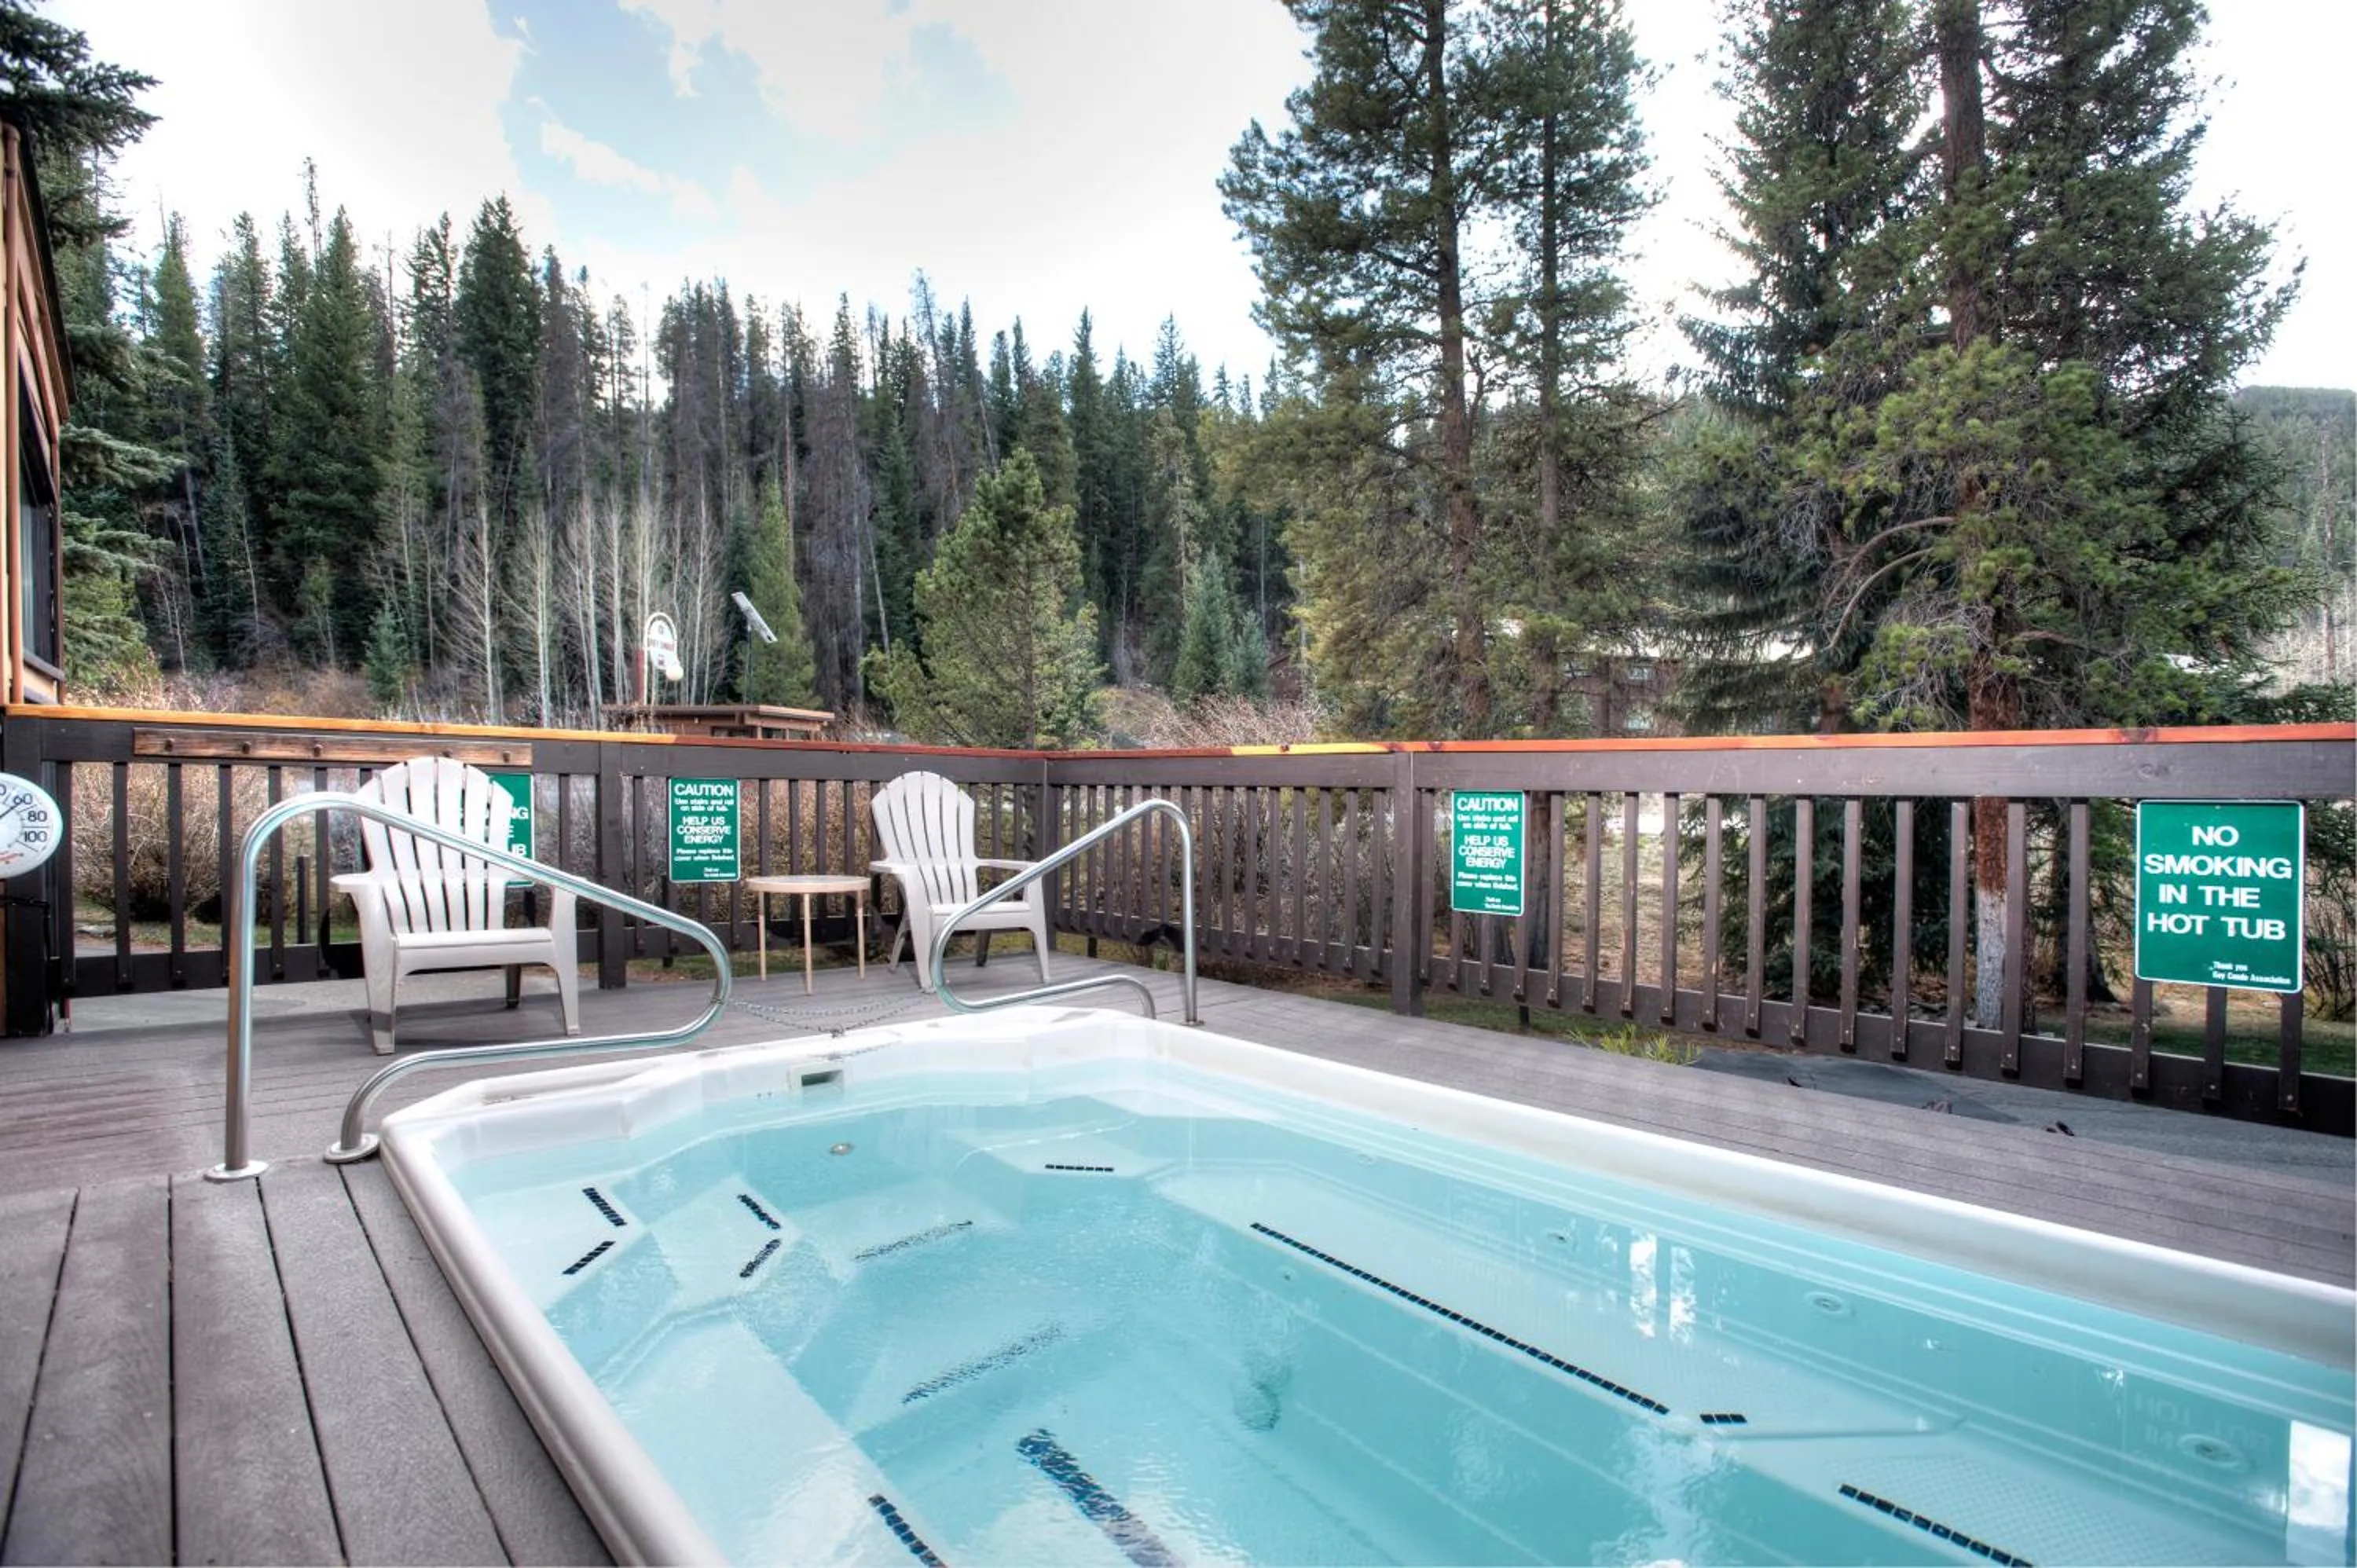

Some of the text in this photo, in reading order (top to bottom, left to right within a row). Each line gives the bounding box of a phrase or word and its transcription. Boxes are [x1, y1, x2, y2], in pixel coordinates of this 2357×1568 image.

[674, 783, 734, 797] CAUTION
[13, 793, 33, 805] 60
[1457, 797, 1519, 811] CAUTION
[27, 810, 47, 822] 80
[682, 816, 725, 826] HELP US
[24, 830, 47, 843] 100
[676, 825, 731, 835] CONSERVE
[2191, 826, 2239, 847] NO
[684, 835, 724, 844] ENERGY
[1464, 835, 1508, 847] HELP US
[1458, 845, 1516, 859] CONSERVE
[1465, 856, 1507, 869] ENERGY
[2143, 853, 2292, 879] SMOKING
[2158, 884, 2261, 908] IN THE
[2147, 912, 2286, 941] HOT TUB
[2212, 961, 2233, 970] Thank
[2227, 972, 2249, 981] Condo
[2250, 974, 2291, 985] Association
